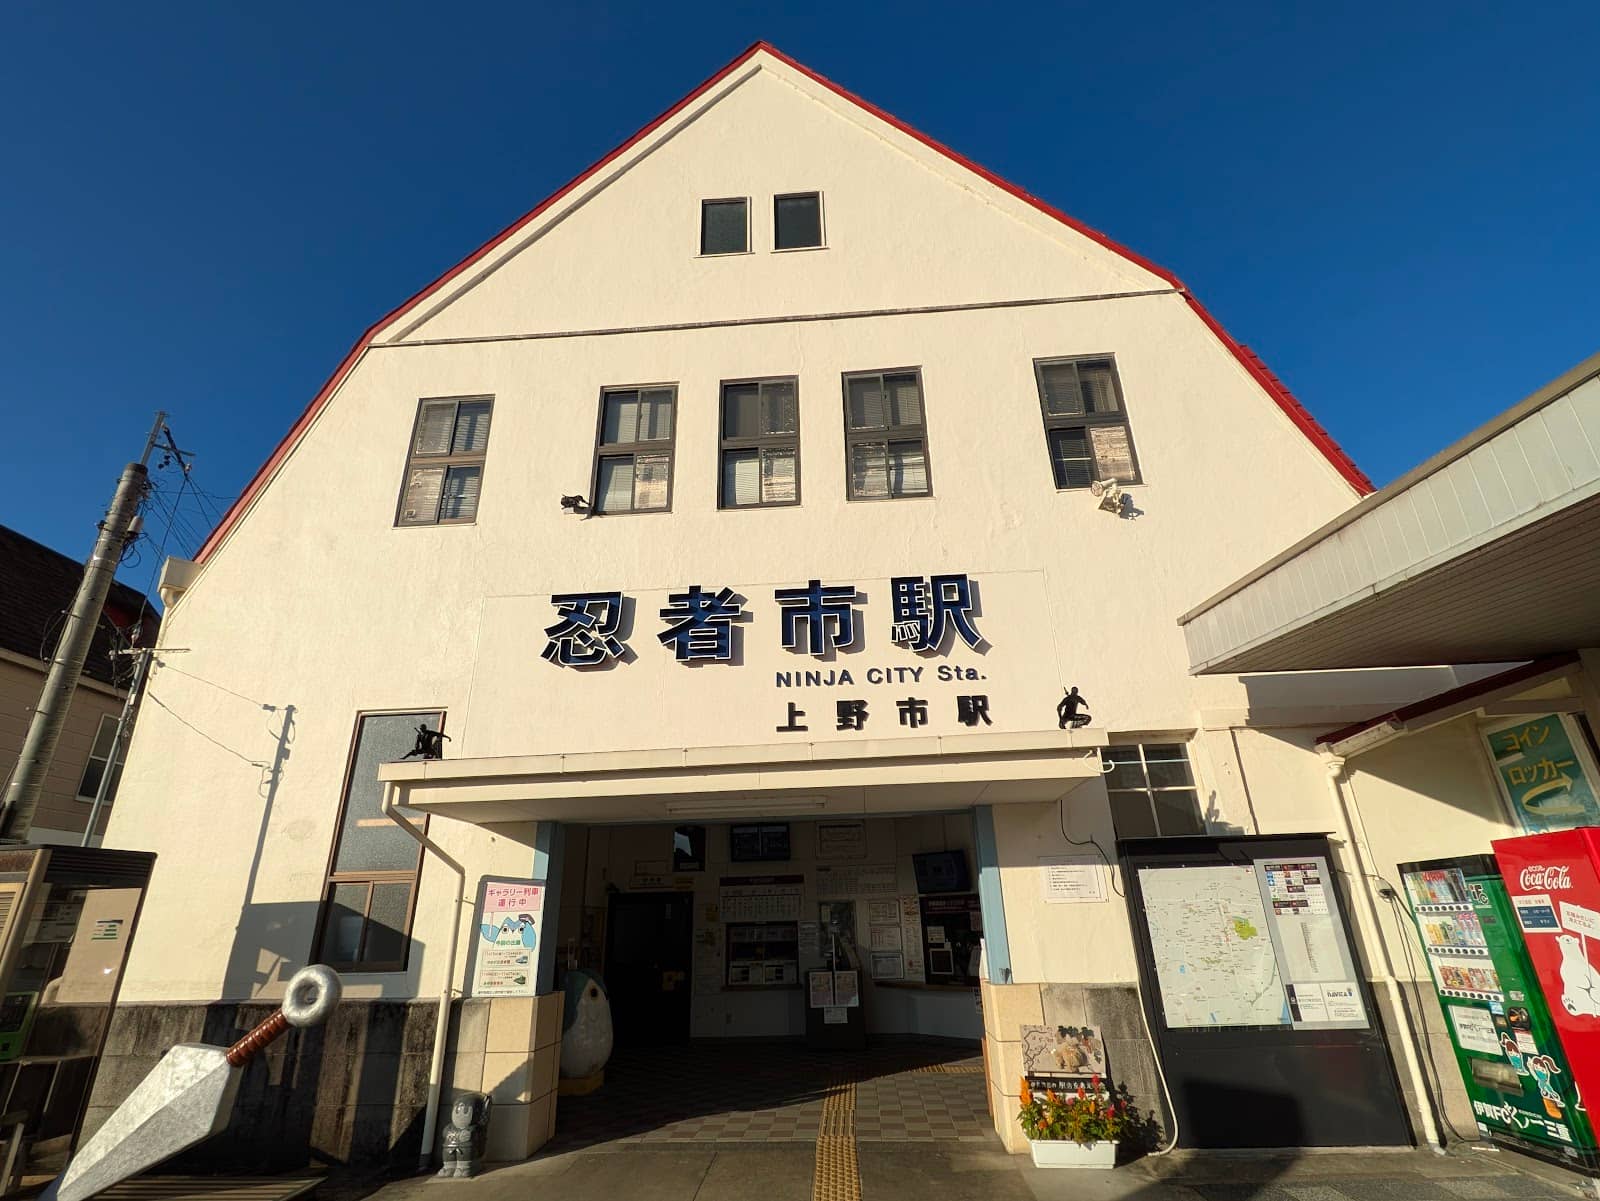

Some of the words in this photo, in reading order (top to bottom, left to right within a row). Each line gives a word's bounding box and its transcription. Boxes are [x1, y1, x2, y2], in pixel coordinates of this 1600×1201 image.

[540, 574, 983, 666] 忍者市駅
[775, 668, 854, 688] NINJA
[866, 666, 924, 685] CITY
[938, 665, 988, 682] Sta.
[776, 695, 993, 732] 上野市駅
[1503, 725, 1550, 751] コイン
[1508, 757, 1574, 785] ロッカー
[1519, 866, 1573, 891] Coca-Cola
[498, 898, 527, 908] 運行中
